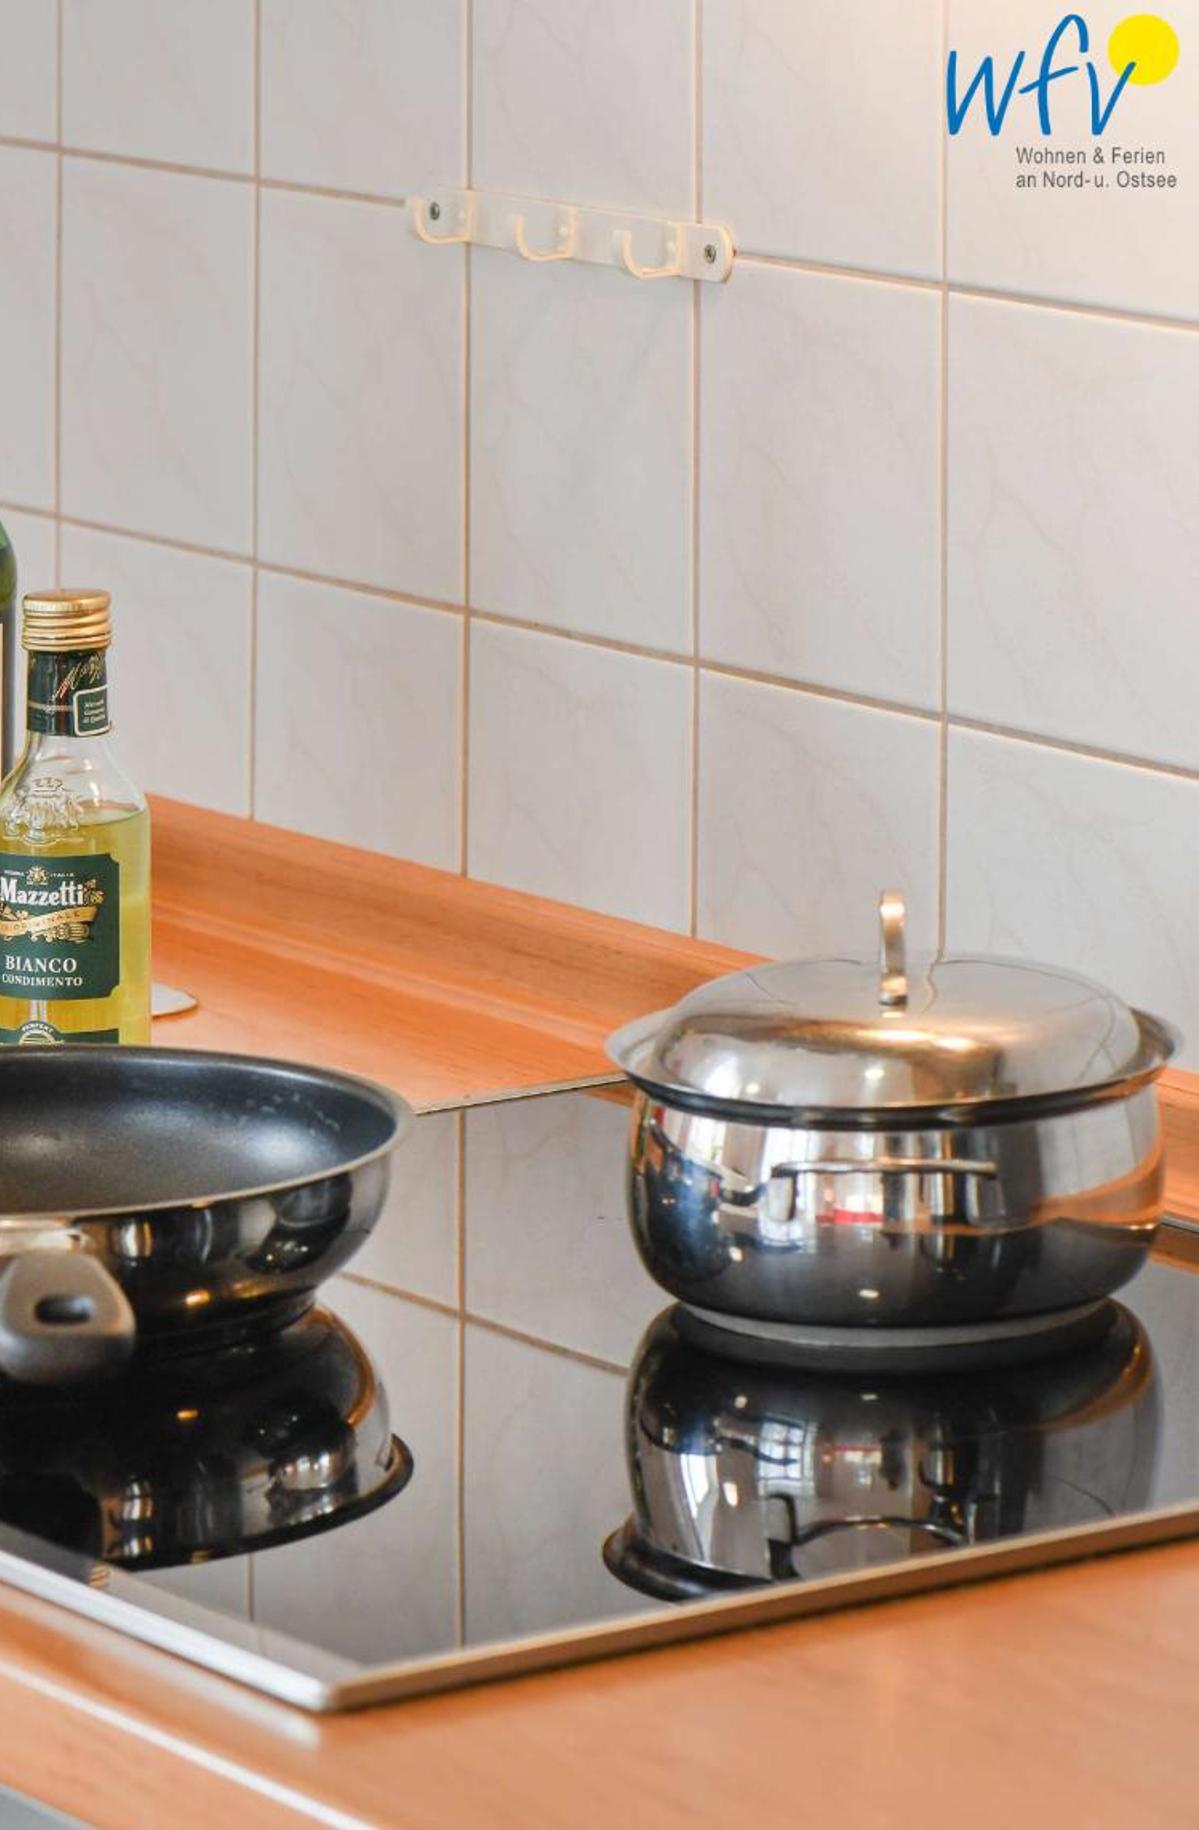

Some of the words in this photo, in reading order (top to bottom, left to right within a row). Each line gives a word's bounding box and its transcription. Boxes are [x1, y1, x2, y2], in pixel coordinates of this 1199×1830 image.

[0, 876, 84, 907] Mazzetti
[5, 955, 77, 973] BIANCO
[2, 973, 83, 987] CONDIMENTO
